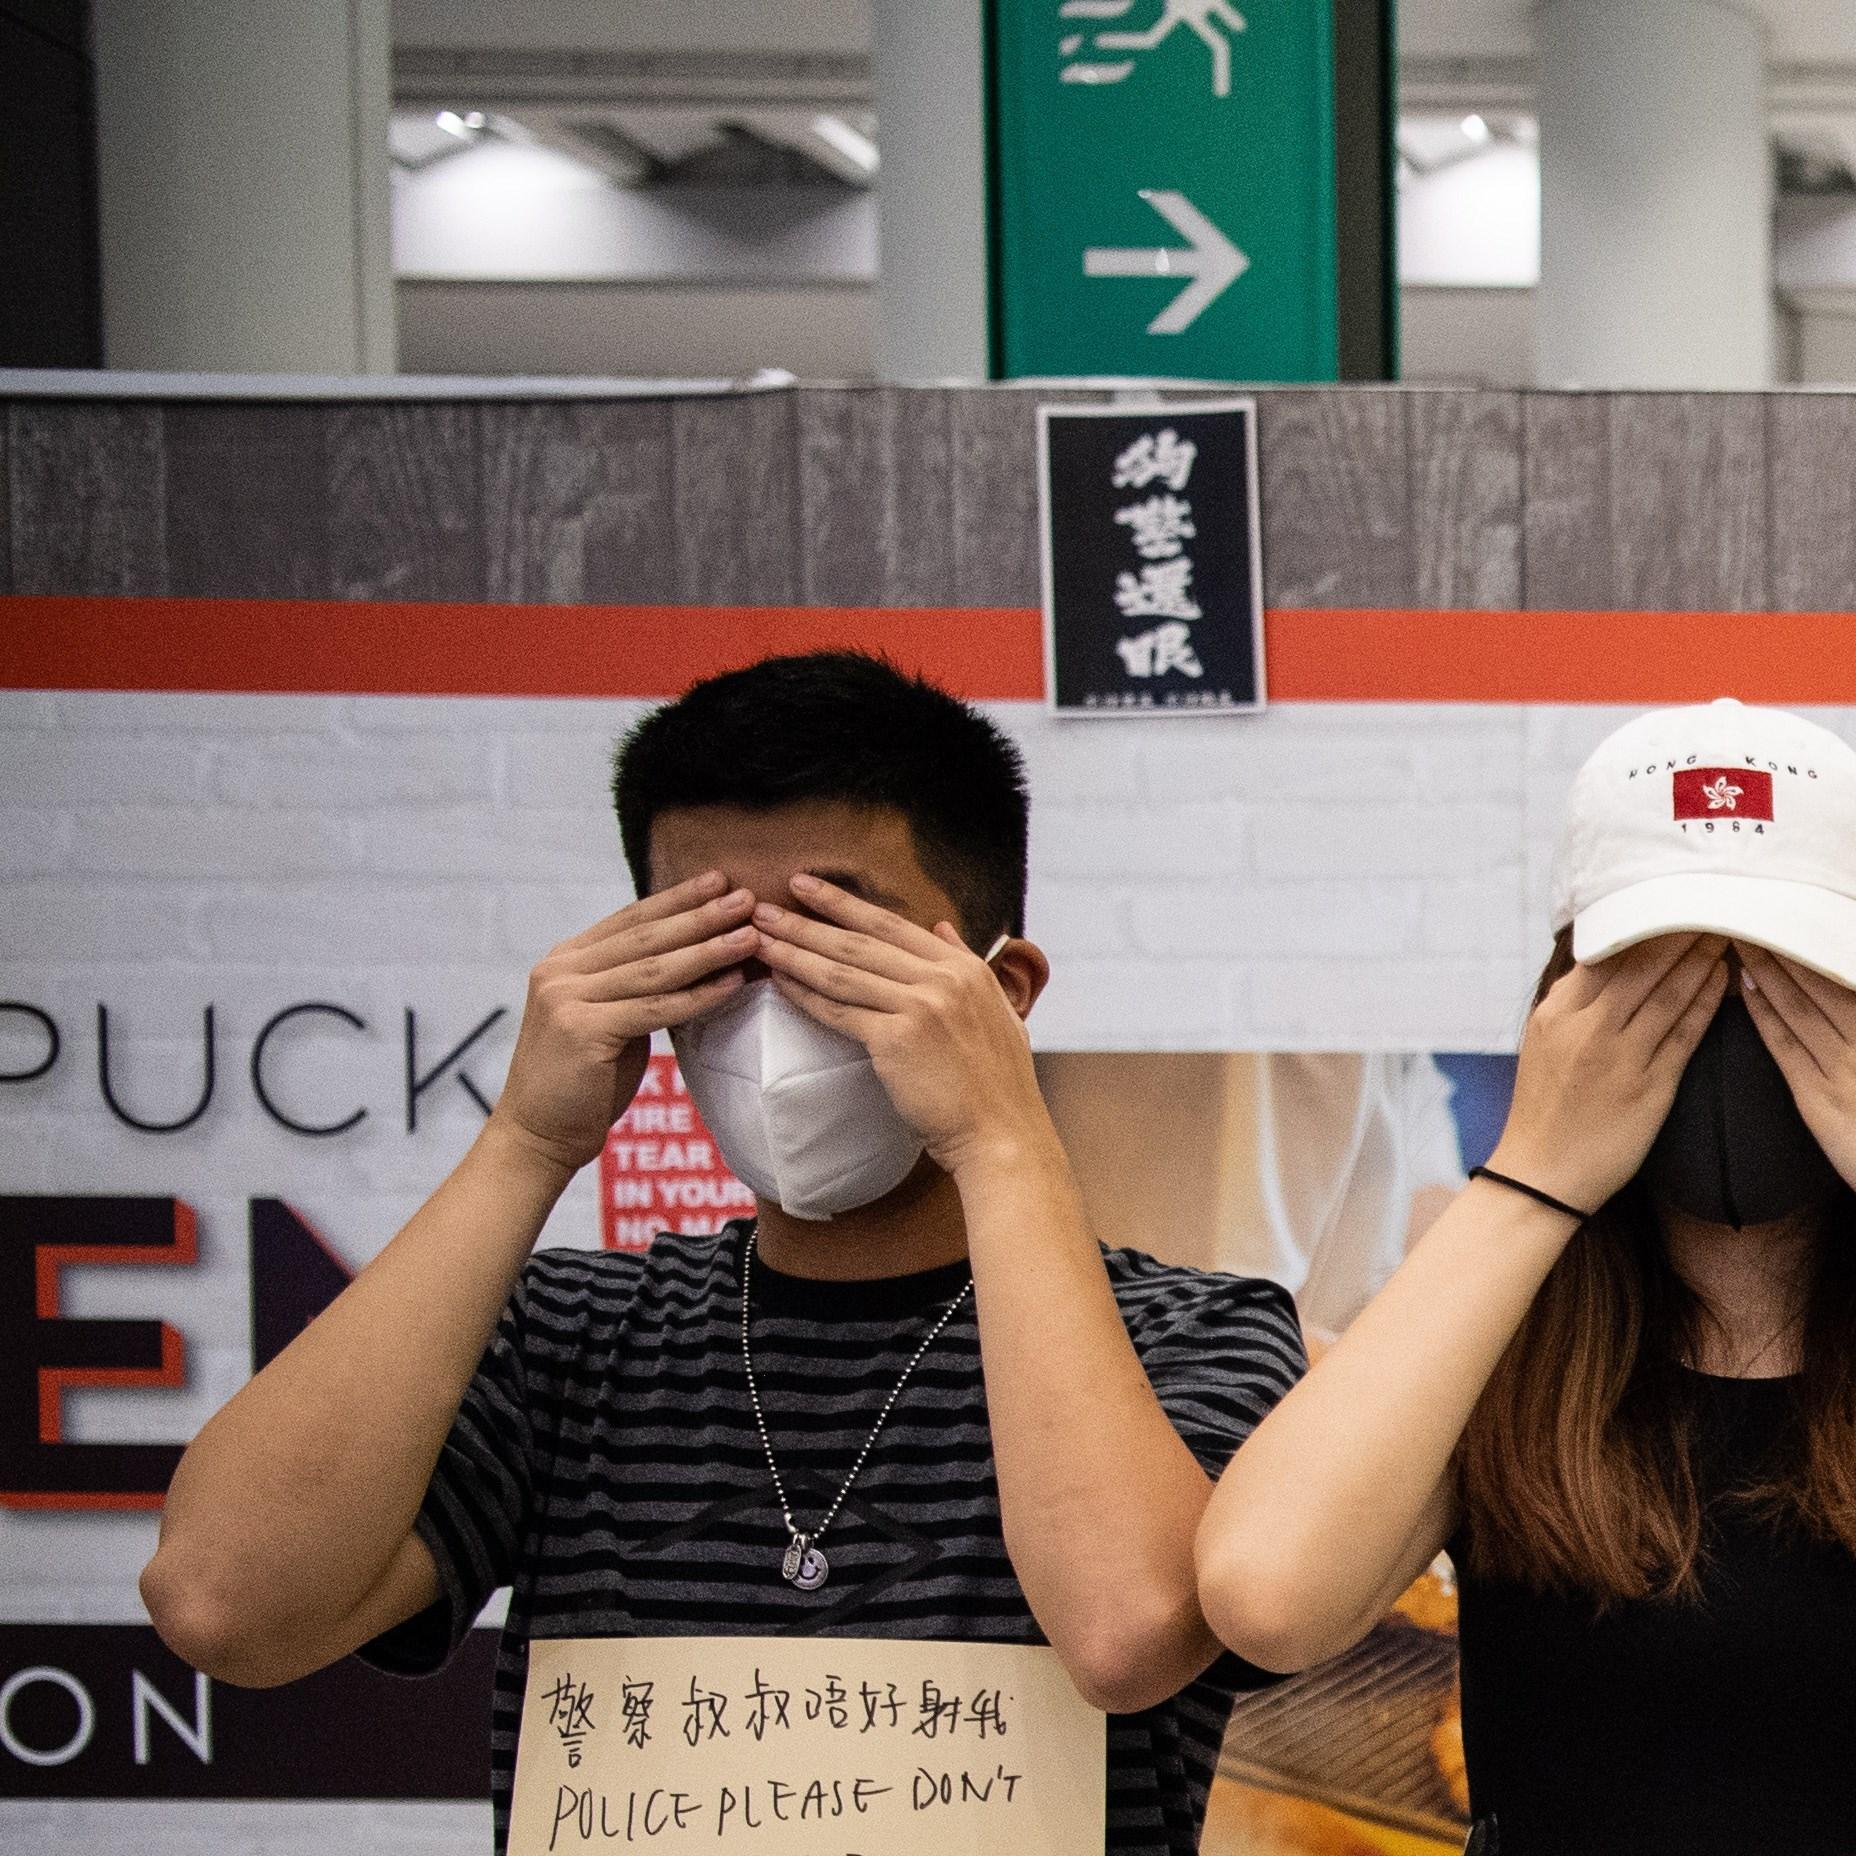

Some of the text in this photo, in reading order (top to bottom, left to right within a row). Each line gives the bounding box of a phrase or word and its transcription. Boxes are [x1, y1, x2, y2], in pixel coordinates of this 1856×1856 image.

[1629, 755, 1818, 780] HONG KONG
[1681, 821, 1764, 835] 1984
[614, 1141, 714, 1170] TEAR
[614, 1178, 652, 1208] IN
[0, 1666, 213, 1766] ON
[541, 1669, 1015, 1767] 警察叔叔唔好射我
[549, 1765, 1022, 1851] POLICE PLEASE DON'T
